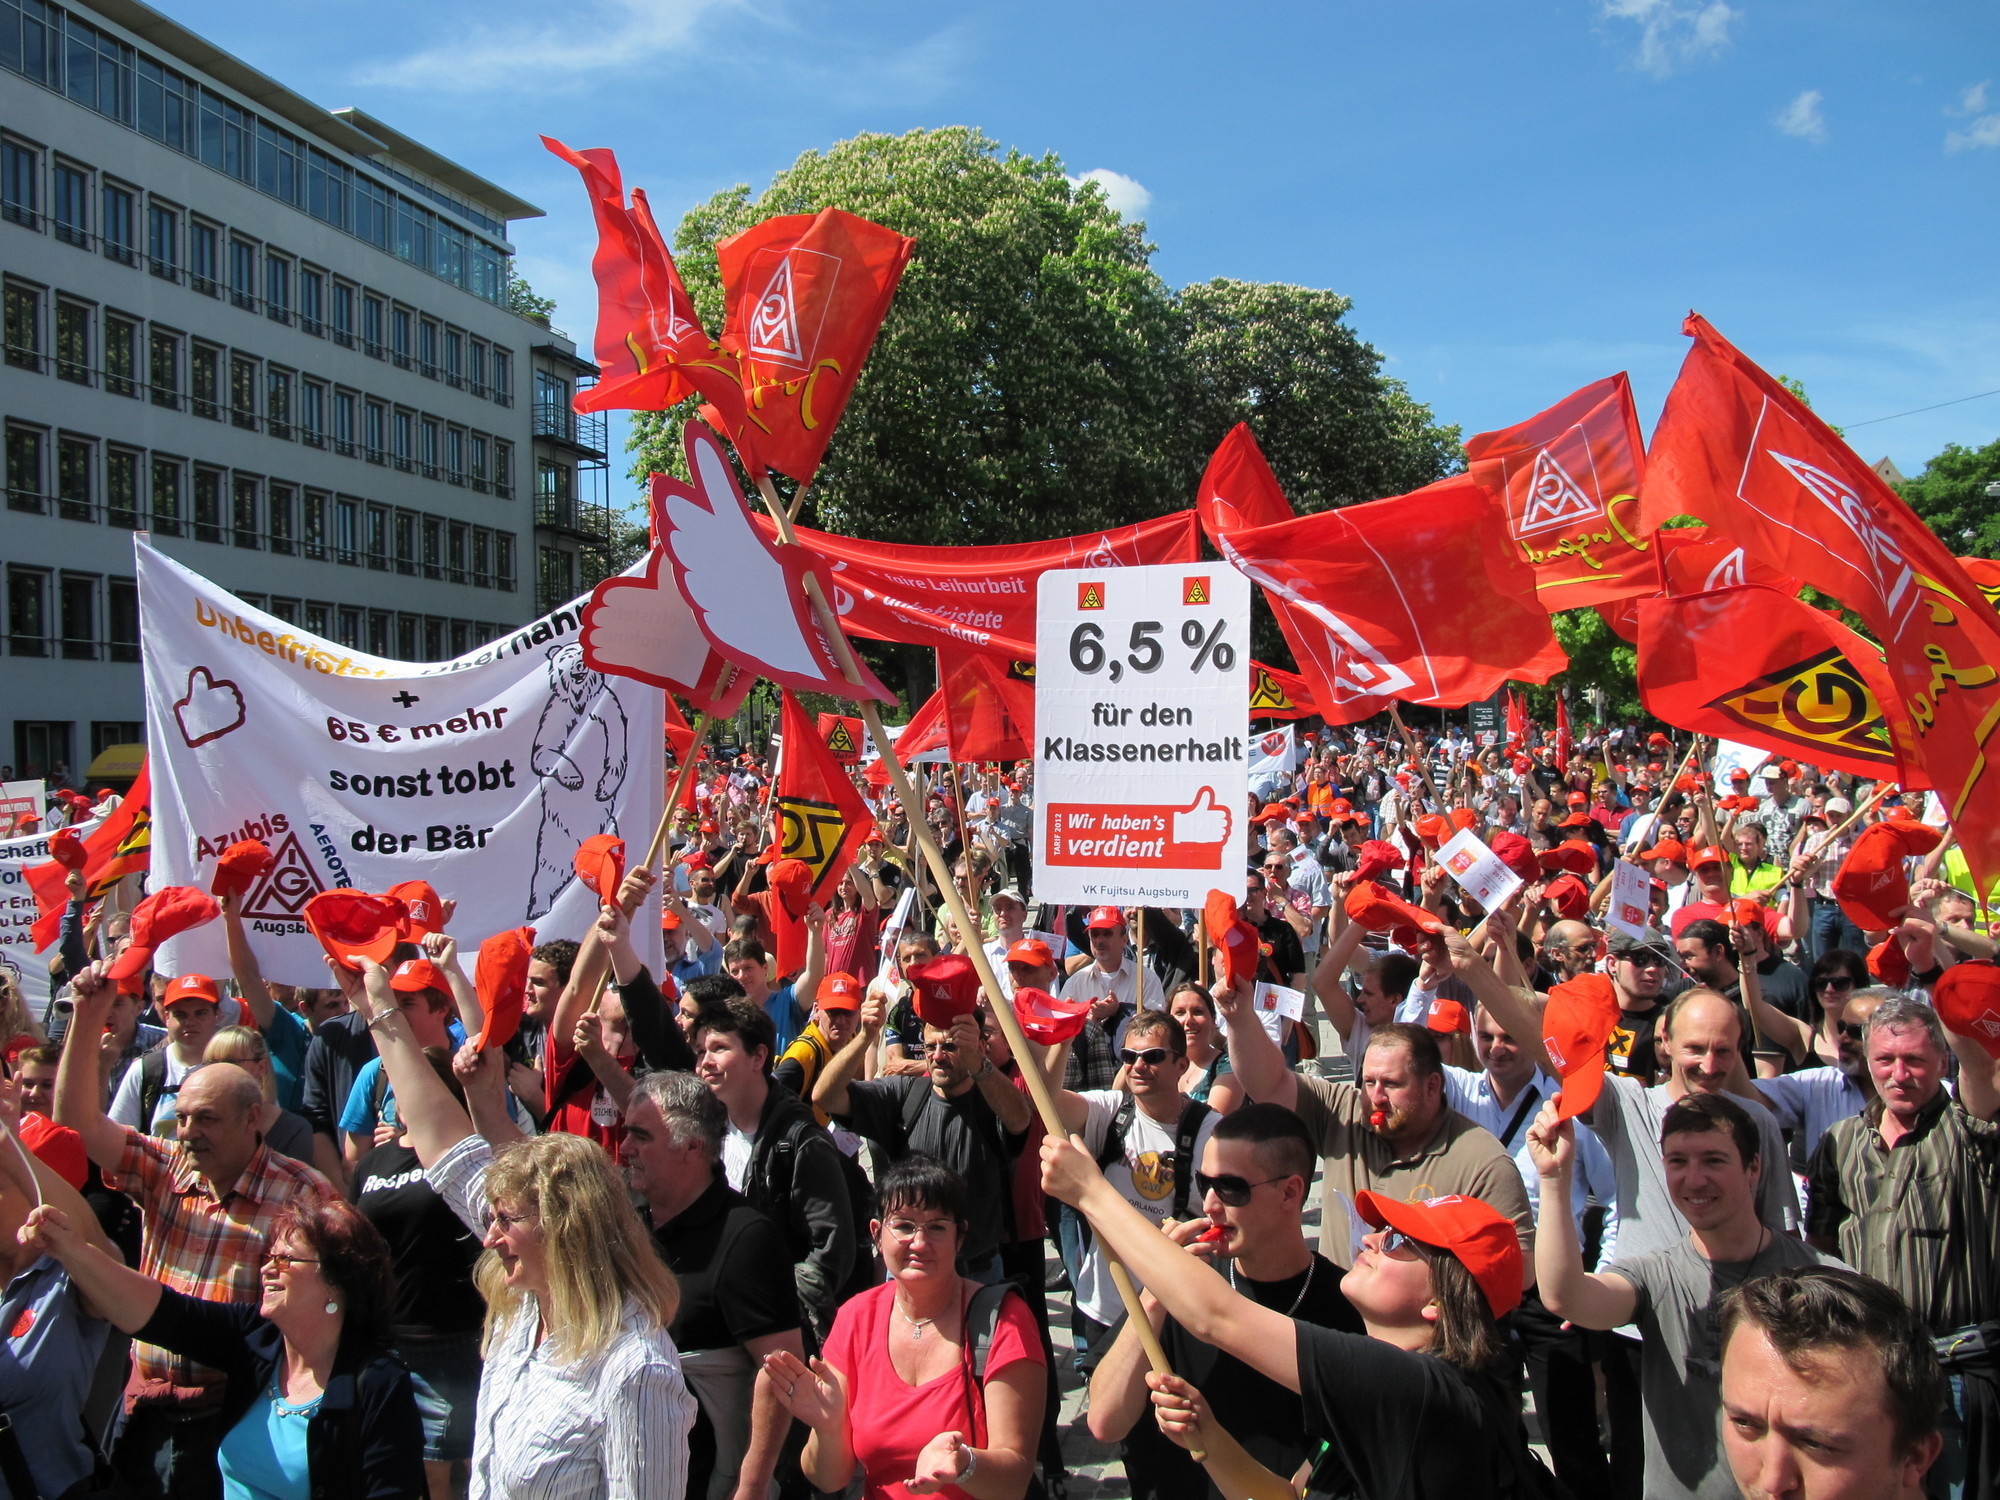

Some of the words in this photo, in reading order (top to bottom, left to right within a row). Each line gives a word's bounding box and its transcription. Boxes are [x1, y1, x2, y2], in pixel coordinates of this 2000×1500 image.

[927, 576, 1027, 595] Leiharbeit
[195, 597, 395, 679] Unbefristet
[1070, 621, 1165, 684] 6,5
[1181, 618, 1236, 675] %
[327, 716, 370, 743] 65
[376, 724, 401, 743] €
[410, 707, 508, 740] mehr
[1091, 702, 1133, 727] für
[1139, 702, 1193, 727] den
[1043, 736, 1244, 763] Klassenerhalt
[330, 768, 434, 798] sonst
[437, 759, 516, 795] tobt
[1053, 813, 1063, 832] 2012
[1068, 813, 1096, 830] Wir
[196, 812, 290, 862] Azubis
[351, 825, 417, 854] der
[426, 824, 494, 852] Bär
[1053, 835, 1062, 856] TARIF
[1067, 834, 1166, 858] verdient
[1082, 885, 1098, 895] VK
[1100, 885, 1136, 898] Fujitsu
[1137, 886, 1190, 899] Augsburg
[1128, 1198, 1165, 1216] ORLANDO
